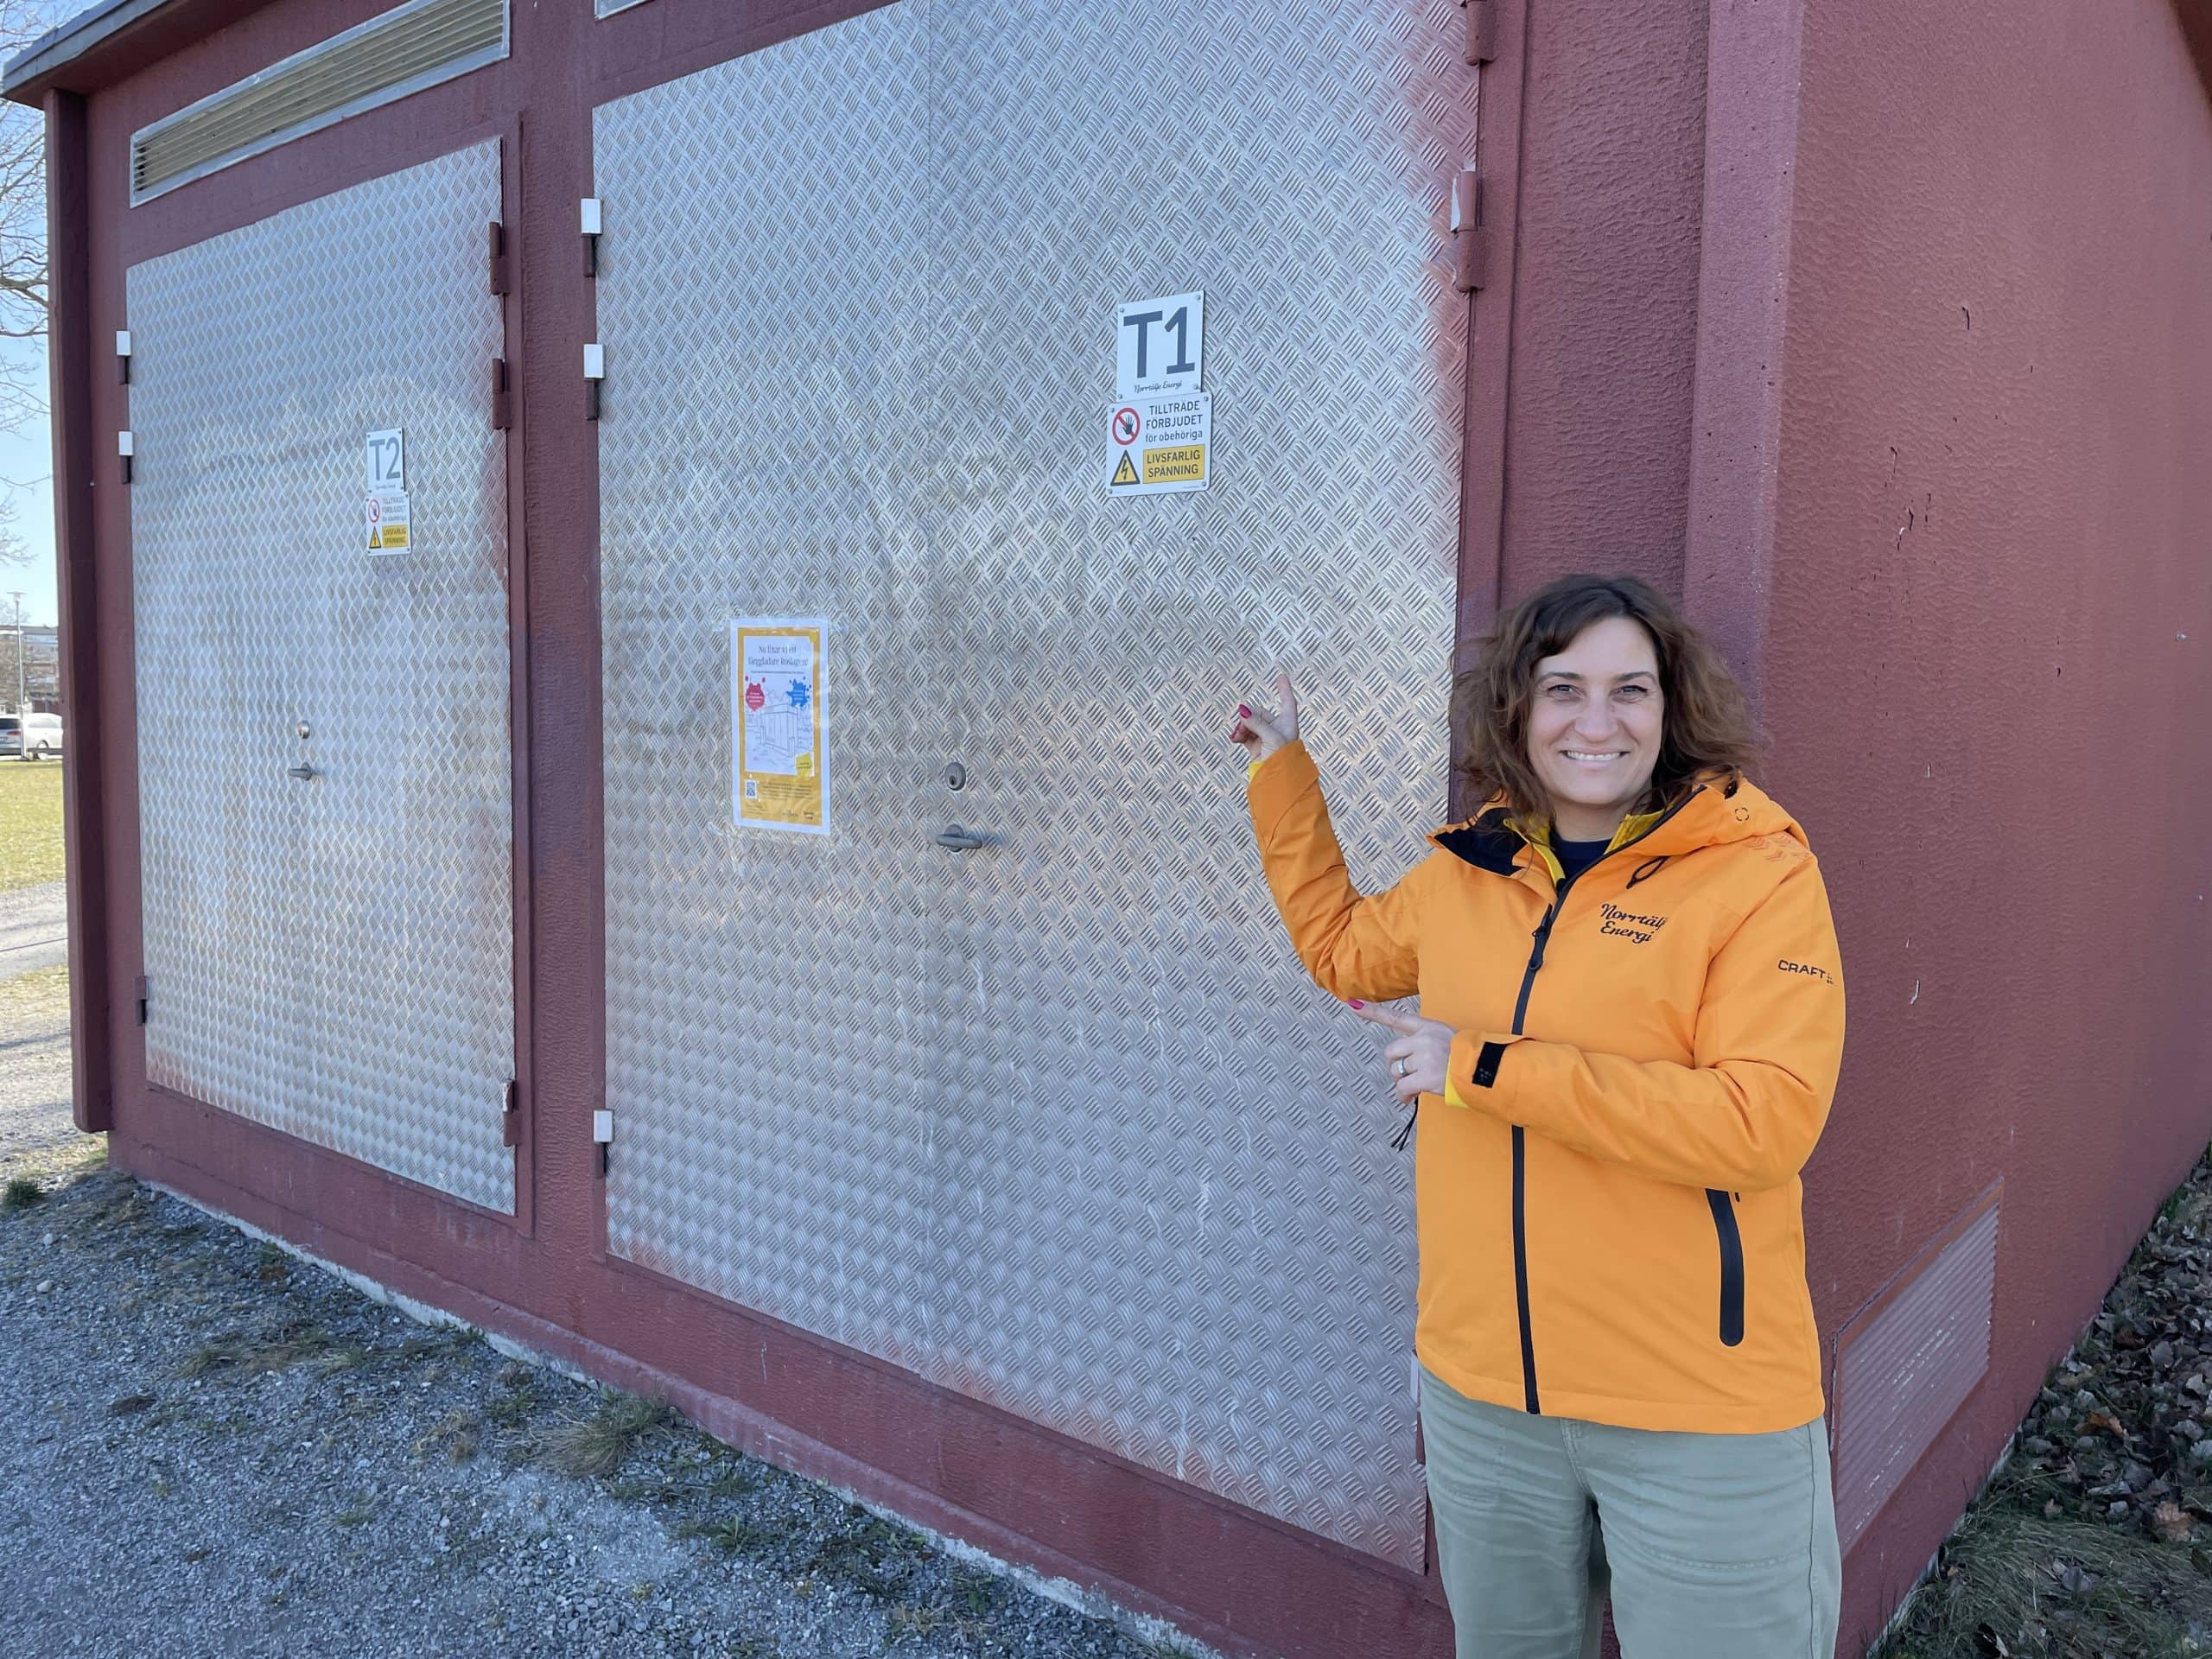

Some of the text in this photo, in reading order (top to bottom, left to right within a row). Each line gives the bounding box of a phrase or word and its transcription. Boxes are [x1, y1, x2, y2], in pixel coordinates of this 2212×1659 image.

[1123, 306, 1195, 378] T1
[1149, 399, 1200, 415] TILLTRÄDE
[1146, 415, 1204, 430] FÖRBJUDET
[1159, 429, 1203, 442] obehöriga
[369, 436, 401, 480] T2
[1147, 449, 1201, 464] LIVSFARLIG
[1147, 464, 1198, 478] SPÄNNING
[1600, 903, 1667, 931] Norrtälj
[1600, 920, 1655, 944] Energi
[1778, 959, 1826, 979] CRAFT
